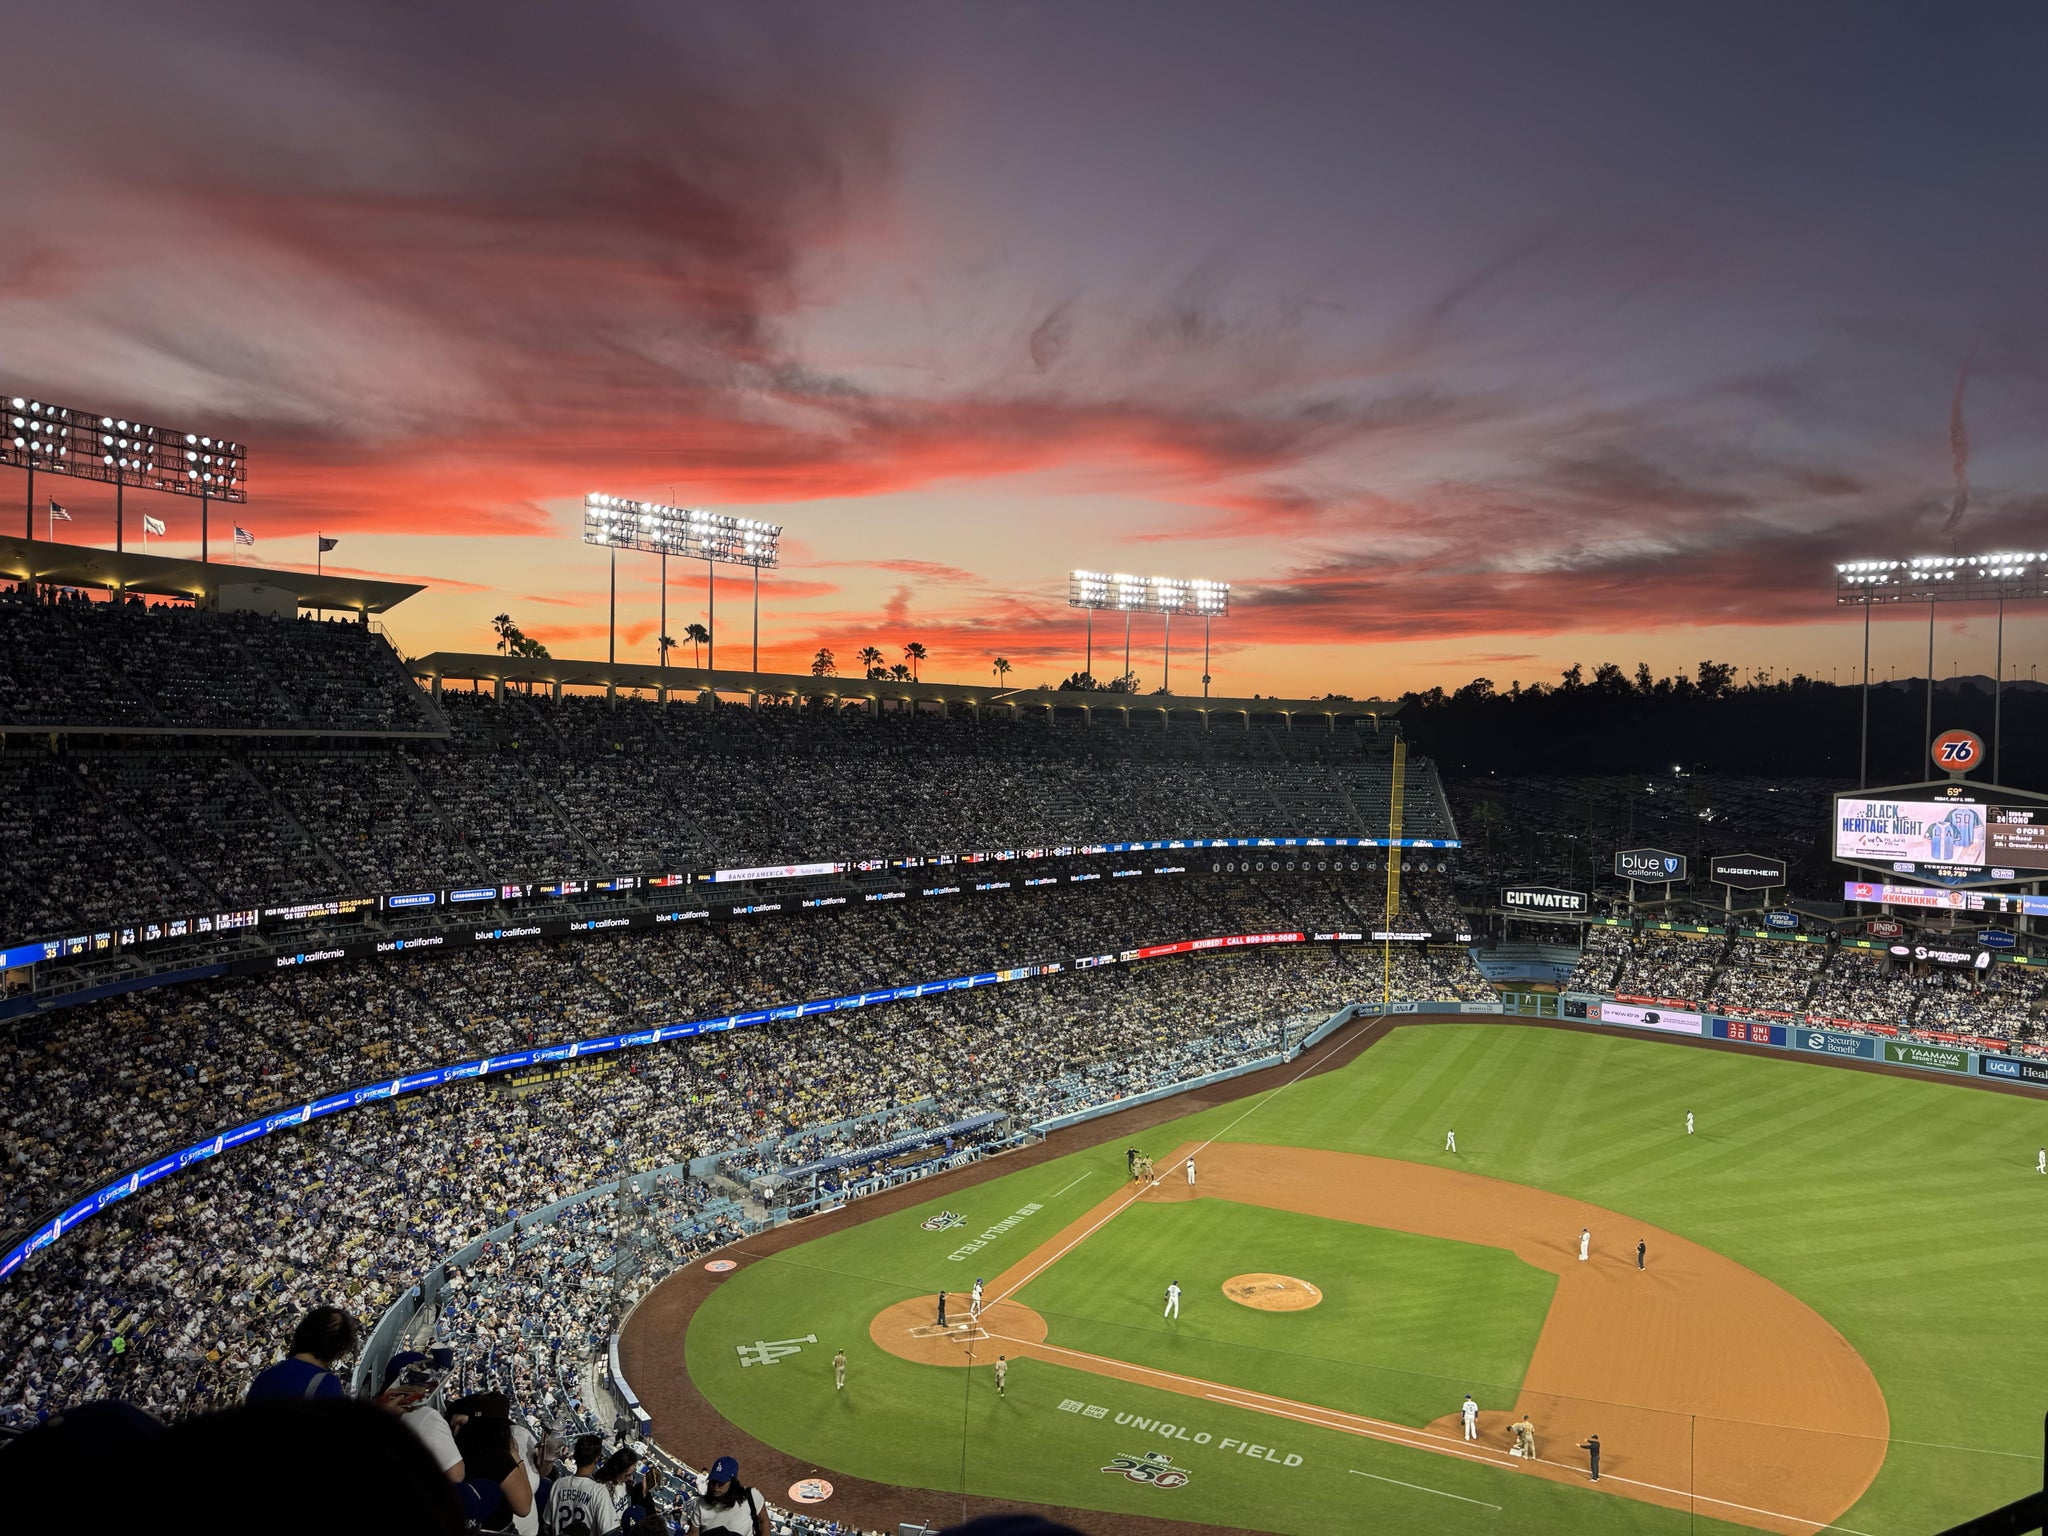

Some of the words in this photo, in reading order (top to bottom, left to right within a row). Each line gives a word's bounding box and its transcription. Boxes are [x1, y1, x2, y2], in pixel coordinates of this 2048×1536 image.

[1942, 741, 1973, 762] 76
[1866, 804, 1899, 819] BLACK
[1842, 817, 1889, 834] HERITAGE
[1892, 819, 1923, 836] NIGHT
[1622, 854, 1660, 870] blue
[756, 870, 784, 878] AMERICA
[1627, 869, 1664, 878] california
[1717, 866, 1779, 877] GUGGENHEIM
[938, 886, 960, 894] california
[820, 896, 847, 906] california
[865, 894, 877, 902] blue
[882, 891, 906, 900] california
[1506, 891, 1580, 909] CUTWATER
[277, 907, 289, 915] FAN
[294, 911, 307, 919] TEXT
[732, 907, 747, 915] blue
[753, 903, 782, 912] california
[656, 914, 672, 922] blue
[678, 910, 709, 920] california
[570, 922, 588, 931] blue
[595, 918, 630, 928] california
[1873, 923, 1898, 932] JINRO
[475, 931, 494, 940] blue
[501, 926, 541, 937] california
[44, 941, 60, 950] BALLS
[67, 936, 88, 946] STRIKES
[95, 932, 111, 941] TOTAL
[46, 949, 57, 959] 35
[72, 945, 83, 954] 66
[96, 939, 109, 949] 101
[122, 934, 135, 945] 8-2
[170, 926, 187, 936] 0.94
[377, 942, 396, 952] blue
[404, 936, 443, 948] california
[1226, 937, 1244, 945] CALL
[277, 956, 296, 967] blue
[304, 948, 345, 962] california
[1928, 950, 1971, 961] SYNCRON
[1752, 1026, 1767, 1034] UNI
[1752, 1033, 1769, 1042] QLO
[1827, 1035, 1861, 1049] Security
[1827, 1045, 1856, 1055] Benefit
[1912, 1055, 1933, 1063] RESORT
[1938, 1059, 1959, 1067] CASINO
[1990, 1063, 2016, 1074] UCLA
[362, 1086, 390, 1099] SYNCRON
[274, 1113, 300, 1127] SYNCRON
[980, 1215, 1025, 1240] UNIQLO
[947, 1239, 989, 1262] FIELD
[1114, 1411, 1213, 1444] UNIQLO
[1219, 1438, 1304, 1467] FIELD
[559, 1489, 592, 1506] KERSHAW
